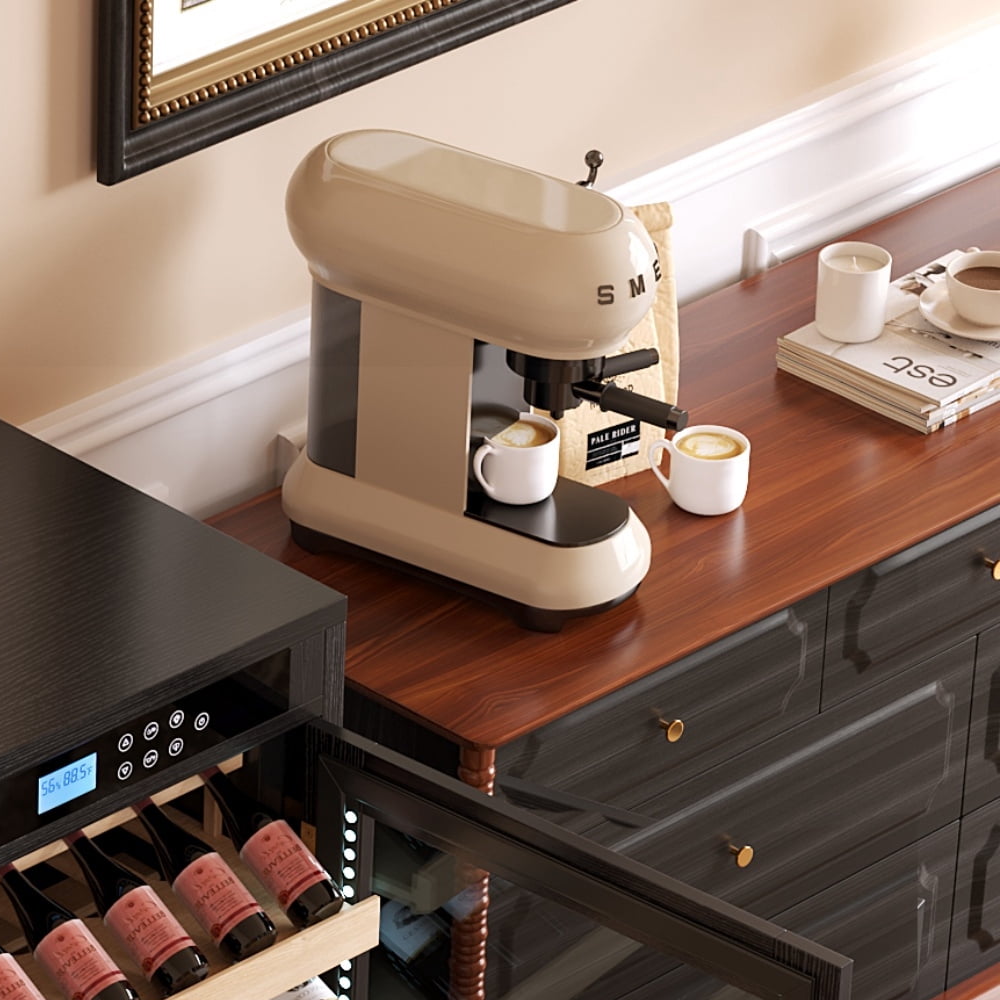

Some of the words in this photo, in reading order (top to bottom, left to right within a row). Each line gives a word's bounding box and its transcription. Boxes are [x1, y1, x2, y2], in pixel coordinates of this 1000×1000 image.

[597, 243, 662, 305] SME
[590, 432, 610, 445] PALE
[611, 424, 637, 439] RIDER
